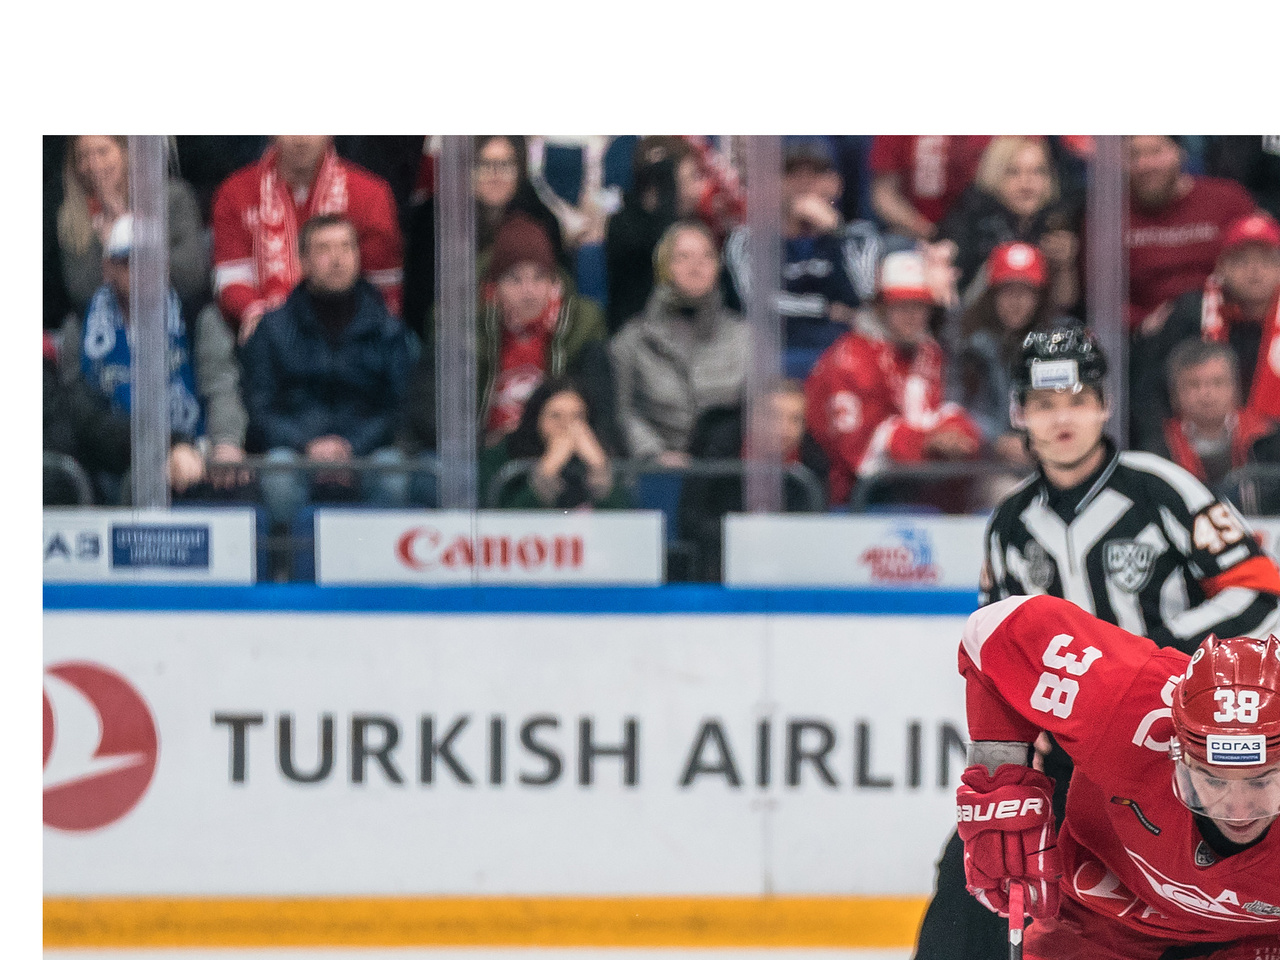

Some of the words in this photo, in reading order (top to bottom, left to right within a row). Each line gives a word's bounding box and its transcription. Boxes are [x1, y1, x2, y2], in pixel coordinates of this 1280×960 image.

[394, 524, 586, 571] Canon
[1192, 503, 1245, 555] 49
[1030, 633, 1103, 719] 38
[1213, 689, 1260, 724] 38
[213, 712, 640, 787] TURKISH
[1211, 741, 1261, 751] СОГАЗ
